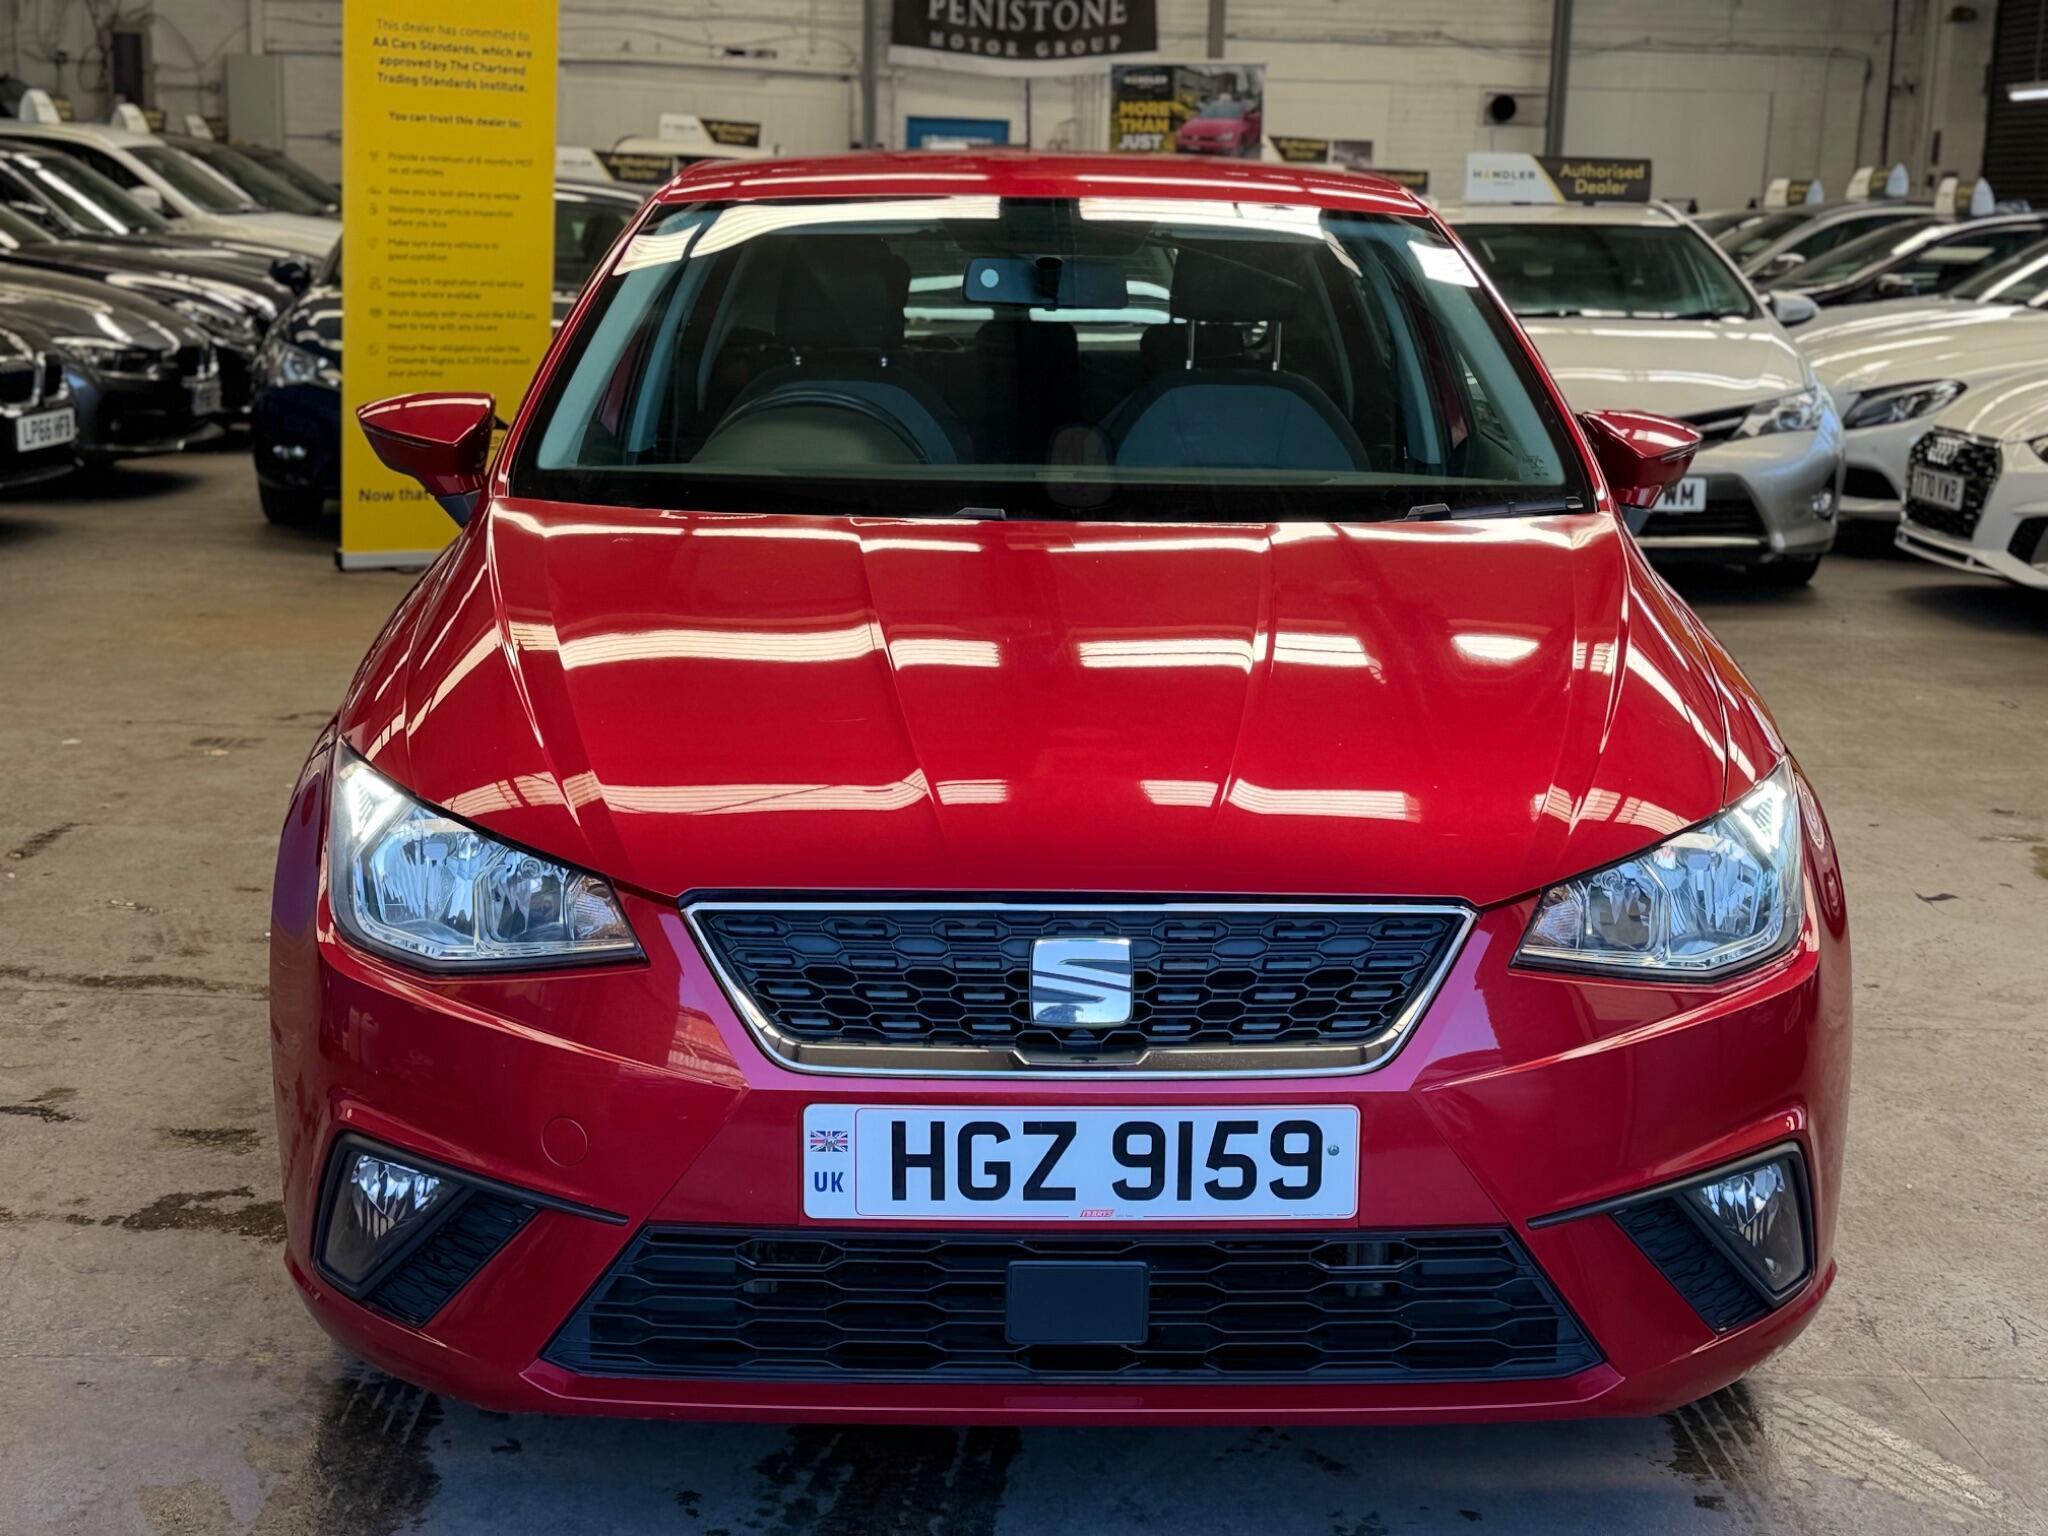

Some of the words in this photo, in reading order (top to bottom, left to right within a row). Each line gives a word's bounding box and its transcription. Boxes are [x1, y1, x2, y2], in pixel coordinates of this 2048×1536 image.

[928, 0, 1127, 31] PENISTONE
[377, 18, 399, 31] This
[401, 21, 433, 33] dealer
[437, 23, 456, 35] has
[459, 26, 516, 40] committed
[518, 31, 529, 41] to
[372, 36, 388, 48] AA
[391, 37, 416, 49] Cars
[419, 40, 479, 55] Standards,
[481, 45, 513, 57] which
[515, 49, 532, 59] are
[929, 30, 1018, 56] MOTOR
[1035, 34, 1121, 57] GROUP
[379, 56, 432, 70] approved
[434, 58, 447, 71] by
[450, 59, 470, 72] The
[472, 61, 526, 76] Chartered
[377, 72, 418, 87] Trading
[420, 74, 476, 89] Standards
[479, 79, 528, 92] Institute.
[1119, 101, 1169, 116] MORE
[388, 111, 407, 121] You
[409, 113, 426, 122] can
[429, 113, 453, 124] trust
[455, 115, 473, 125] this
[475, 116, 506, 127] dealer
[1119, 118, 1168, 132] THAN
[1119, 134, 1163, 149] JUST
[1560, 163, 1645, 179] Authorised
[1575, 180, 1628, 194] Dealer
[359, 488, 395, 502] Now
[891, 1120, 1077, 1201] HGZ
[1111, 1119, 1324, 1201] 9159
[814, 1171, 844, 1193] UK
